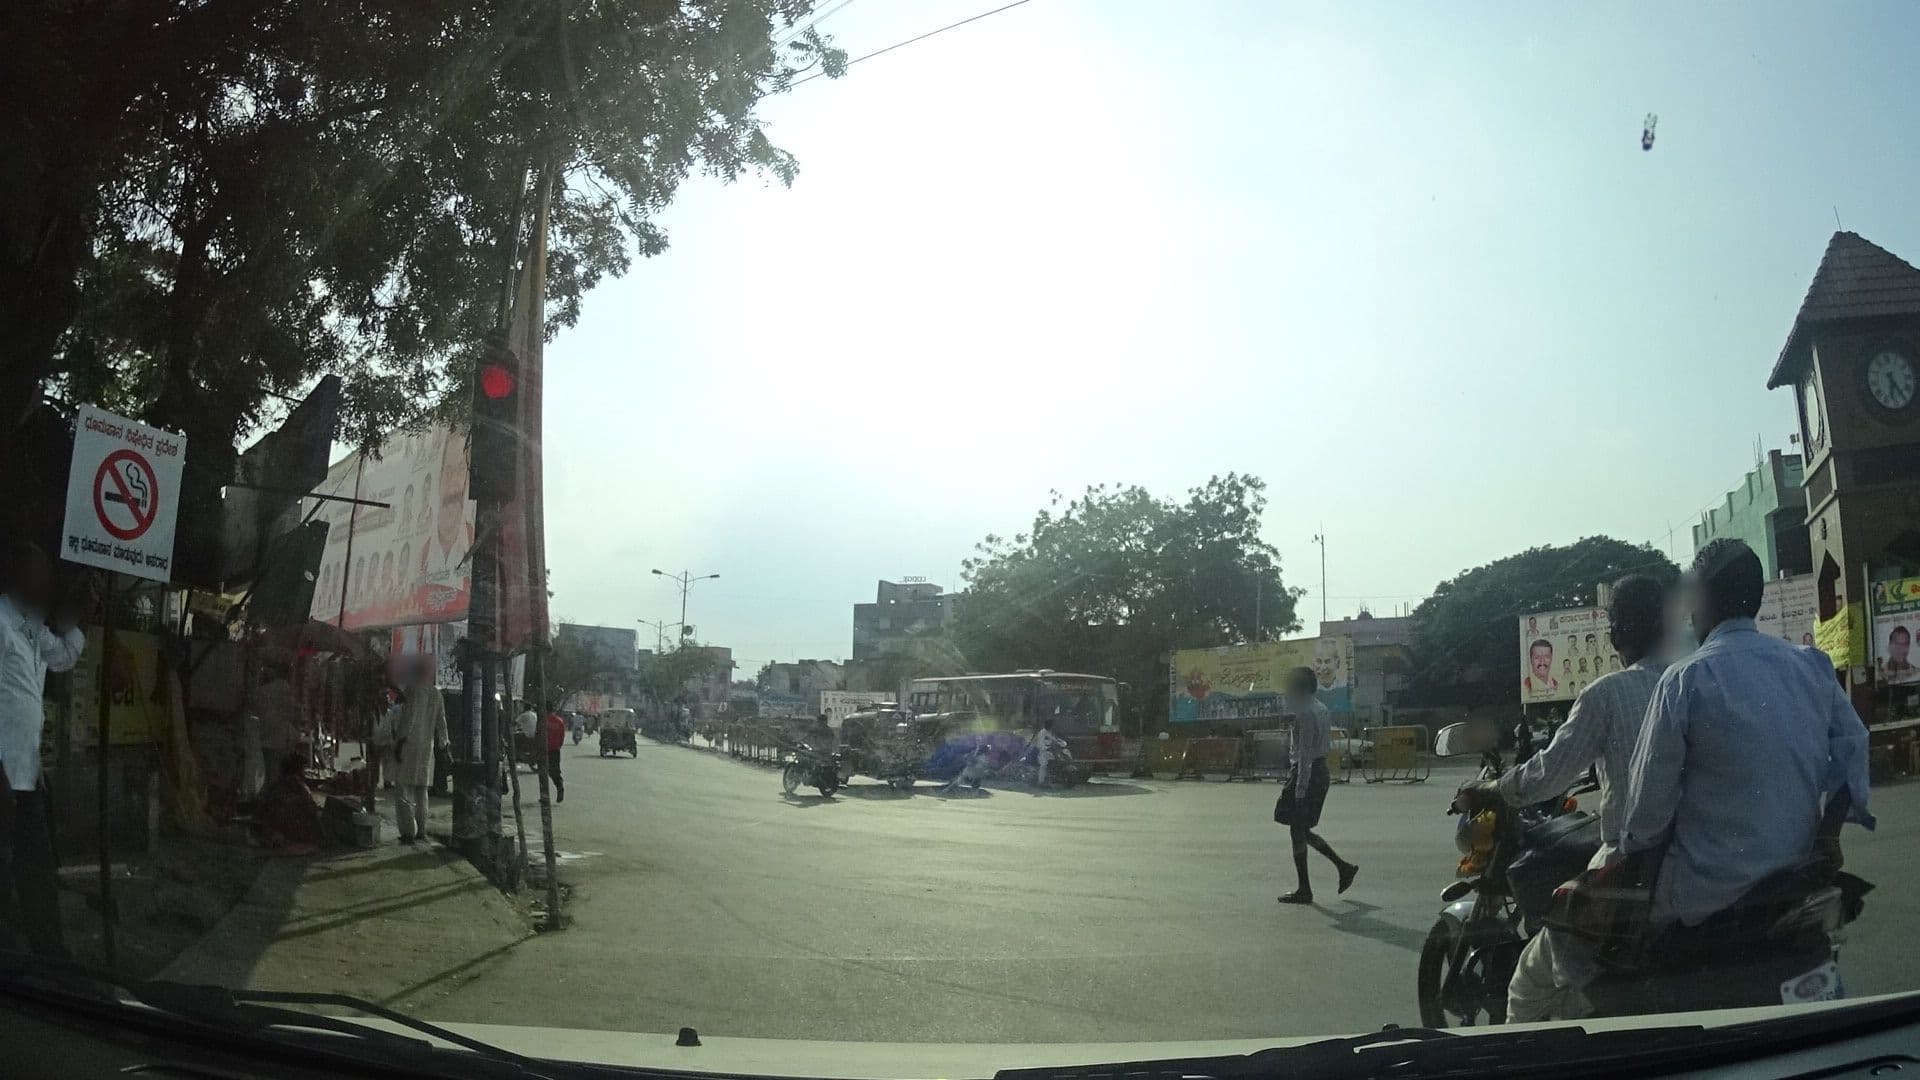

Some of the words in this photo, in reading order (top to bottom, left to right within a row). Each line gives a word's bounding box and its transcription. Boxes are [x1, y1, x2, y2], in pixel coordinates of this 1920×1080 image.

[85, 415, 123, 439] ಧೂಮಪಾನ
[155, 439, 179, 457] ಪ್ರದೇಶ
[81, 536, 113, 556] ಧೂಮಪಾನ
